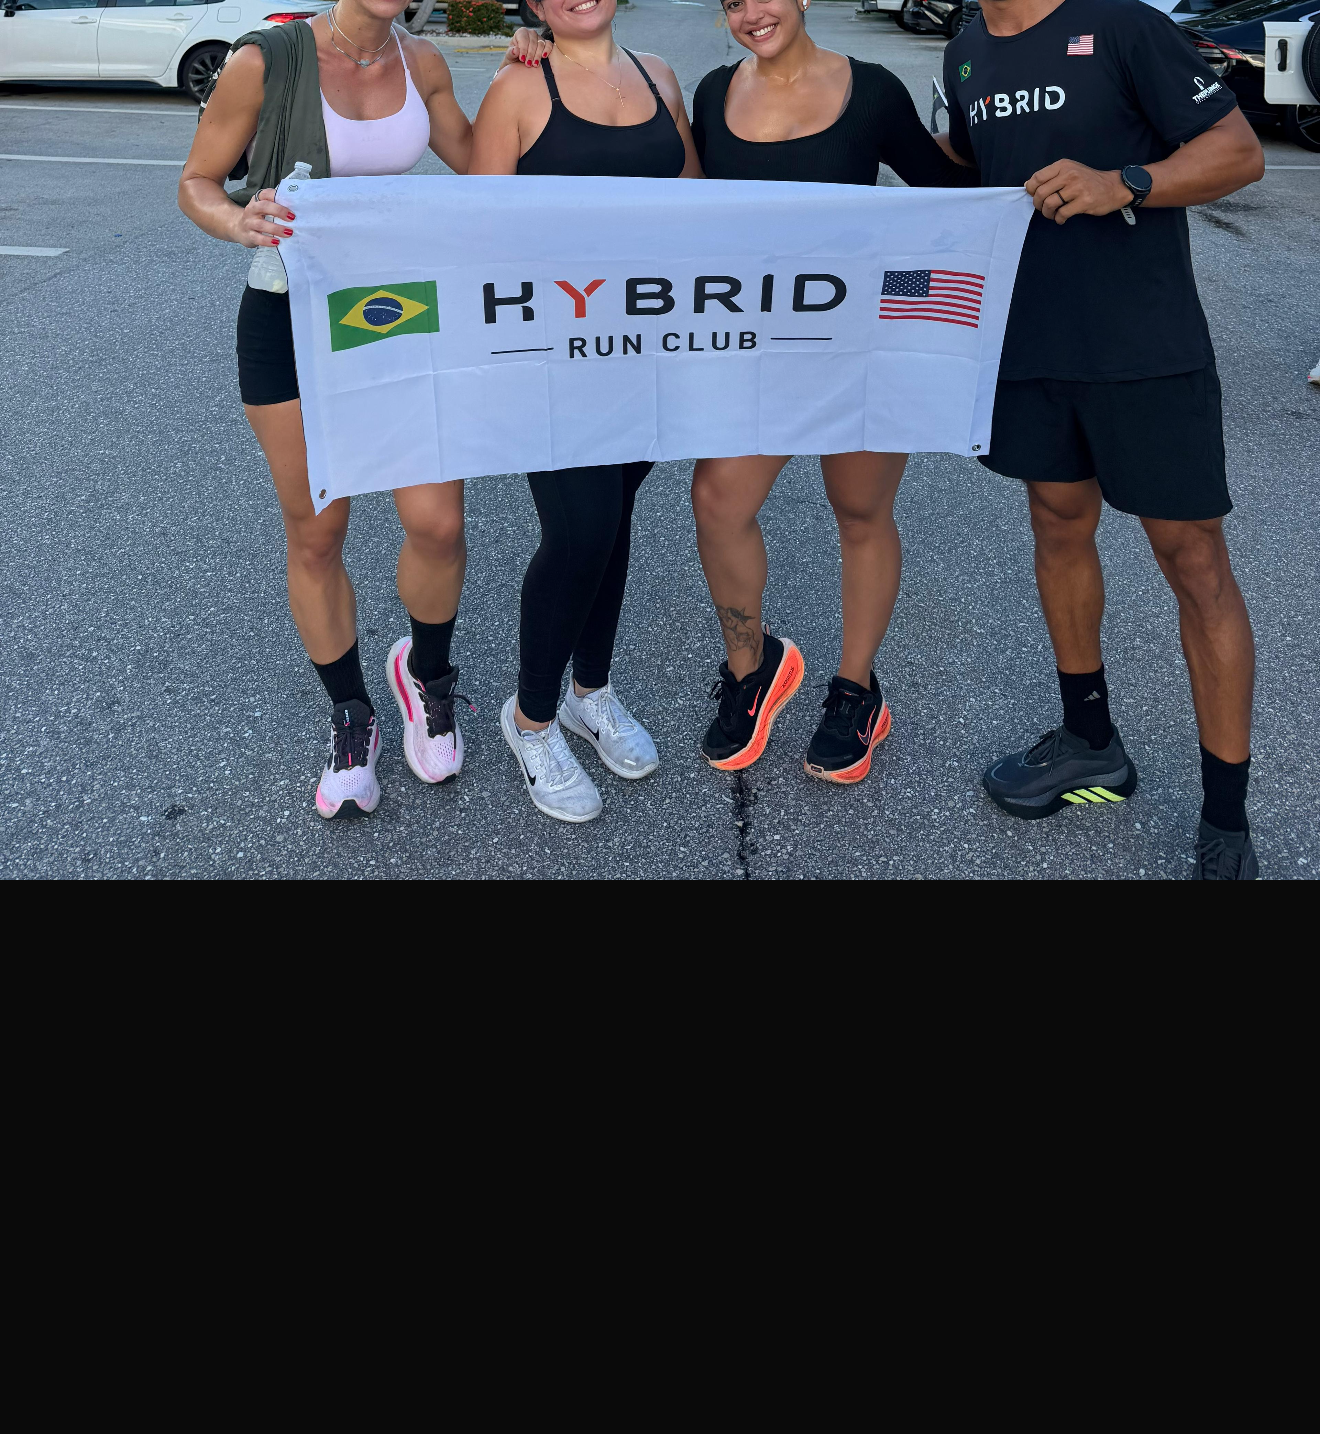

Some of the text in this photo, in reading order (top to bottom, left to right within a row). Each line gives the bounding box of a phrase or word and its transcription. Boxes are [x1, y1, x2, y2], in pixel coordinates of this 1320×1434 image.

[969, 85, 1066, 127] HYBRID
[482, 273, 848, 325] HYBRID
[568, 330, 757, 359] RUN CLUB
